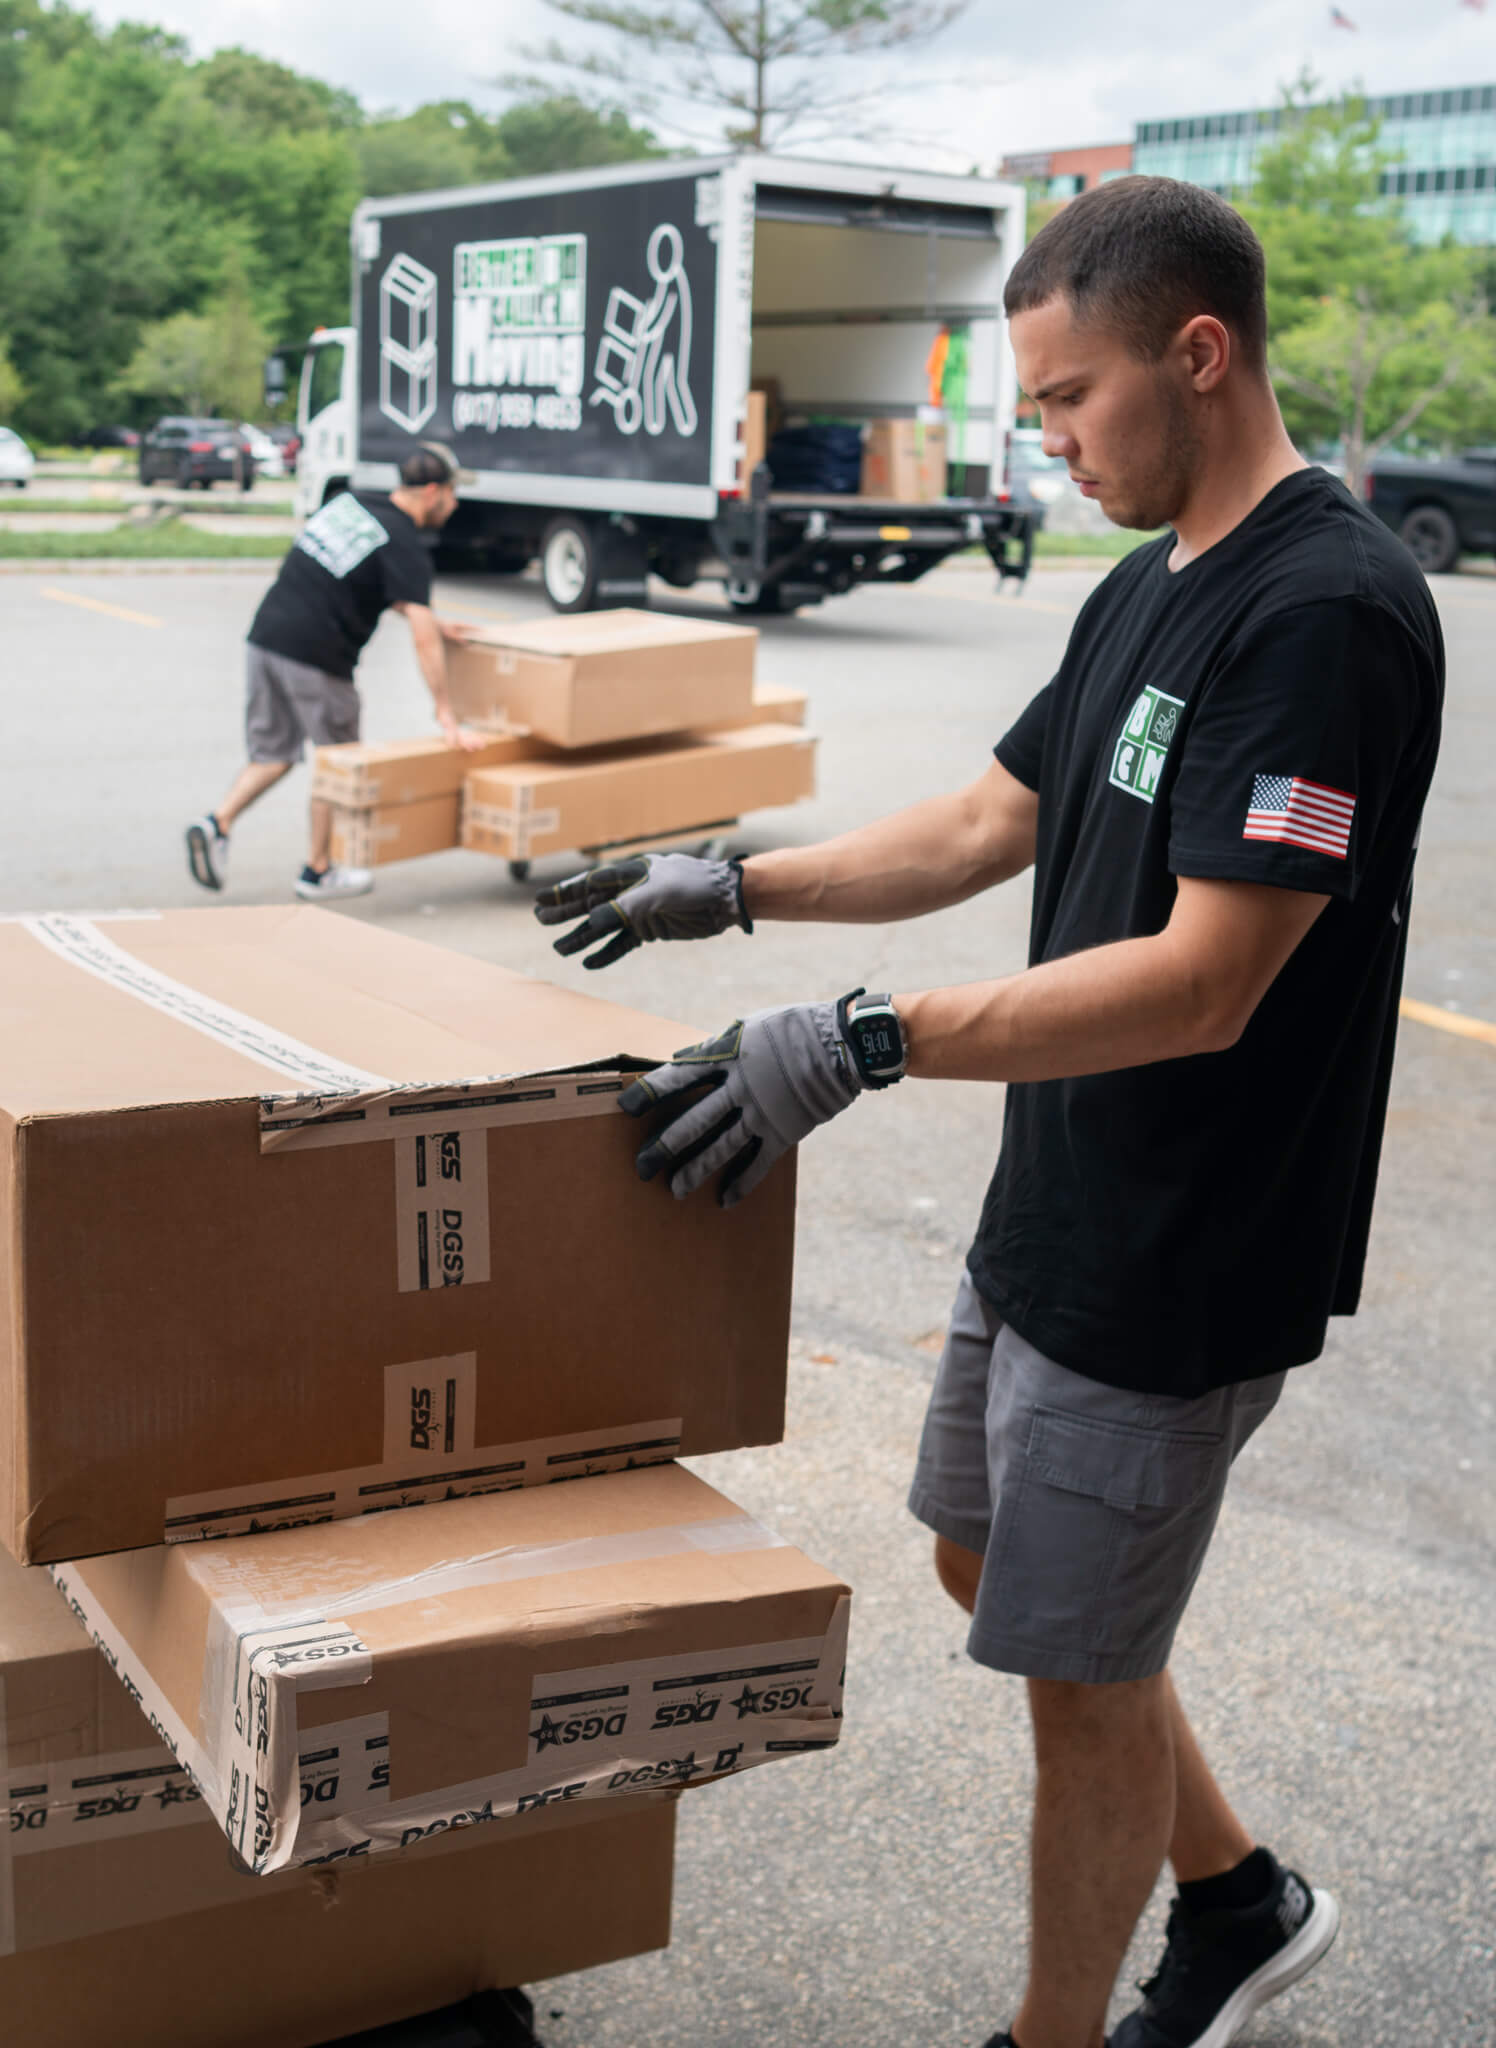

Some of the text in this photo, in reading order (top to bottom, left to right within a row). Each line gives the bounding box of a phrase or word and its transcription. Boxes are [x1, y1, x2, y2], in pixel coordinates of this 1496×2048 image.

[453, 296, 585, 395] Moving
[861, 1031, 891, 1055] 10:15
[442, 1209, 464, 1271] DGS
[410, 1386, 432, 1450] DGS
[562, 1712, 628, 1745] DGS
[650, 1699, 721, 1730] DGS
[606, 1760, 672, 1790] DGS
[71, 1794, 143, 1823] DGS
